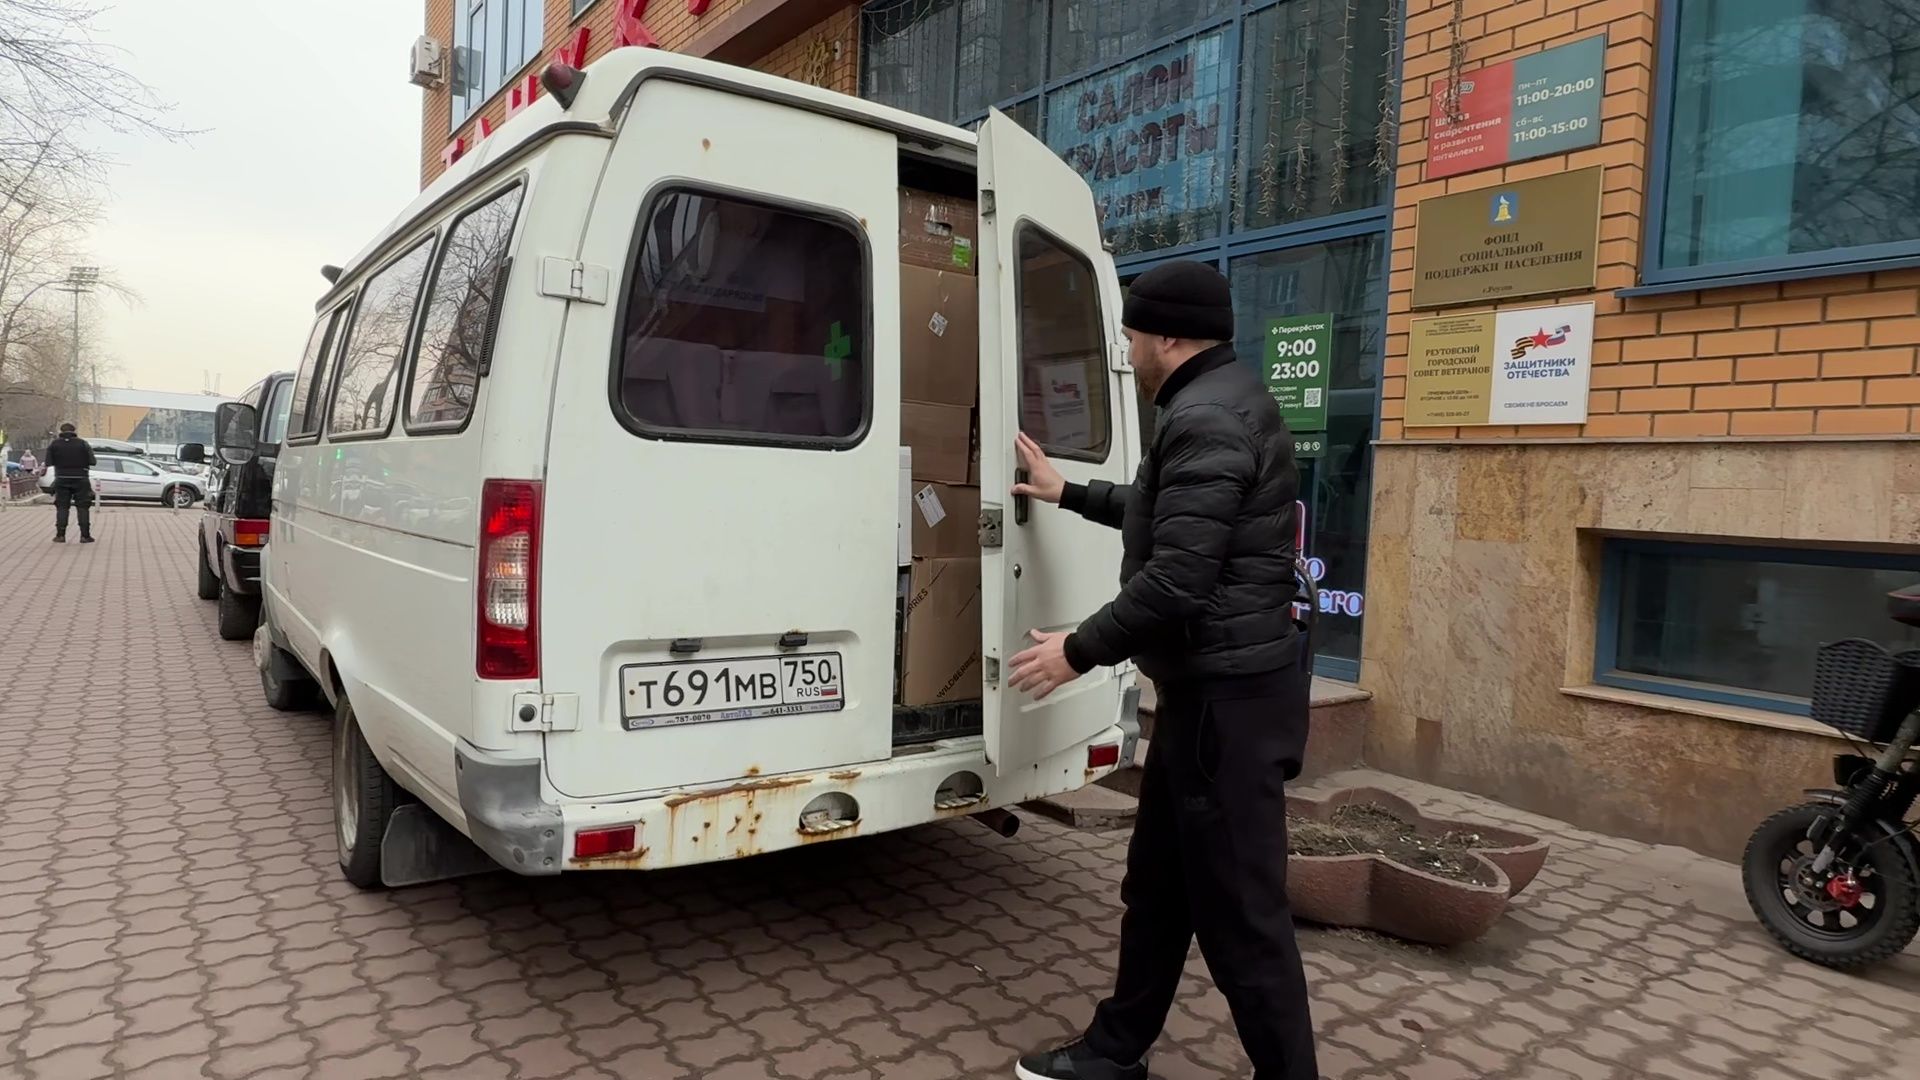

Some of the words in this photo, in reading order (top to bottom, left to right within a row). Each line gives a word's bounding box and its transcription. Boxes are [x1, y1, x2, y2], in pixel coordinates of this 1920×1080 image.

[1077, 55, 1195, 133] САЛОН
[1516, 77, 1595, 106] 11:00-20:00
[1434, 117, 1502, 140] скорочтения
[1513, 117, 1588, 143] 11:00-15:00
[1440, 134, 1483, 151] развития
[1432, 144, 1485, 162] интеллекта
[1484, 232, 1520, 246] ФОНД
[1459, 241, 1544, 263] СОЦИАЛЬНОЙ
[1424, 262, 1499, 281] ПОДДЕРЖКИ
[1504, 250, 1583, 270] НАСЕЛЕНИЯ
[1278, 323, 1325, 334] Перекрёсток
[1277, 338, 1316, 357] 9:00
[1425, 344, 1480, 357] РЕУТОВСКИЙ
[1271, 360, 1320, 380] 23:00
[1427, 356, 1477, 367] ГОРОДСКОЙ
[1504, 358, 1576, 370] ЗАЩИТНИКИ
[1413, 369, 1440, 378] СОВЕТ
[1441, 366, 1490, 377] ВЕТЕРАНОВ
[1507, 369, 1570, 380] ОТЕЧЕСТВА
[1274, 394, 1297, 403] одукты
[784, 659, 832, 687] 750
[797, 687, 820, 698] RUS
